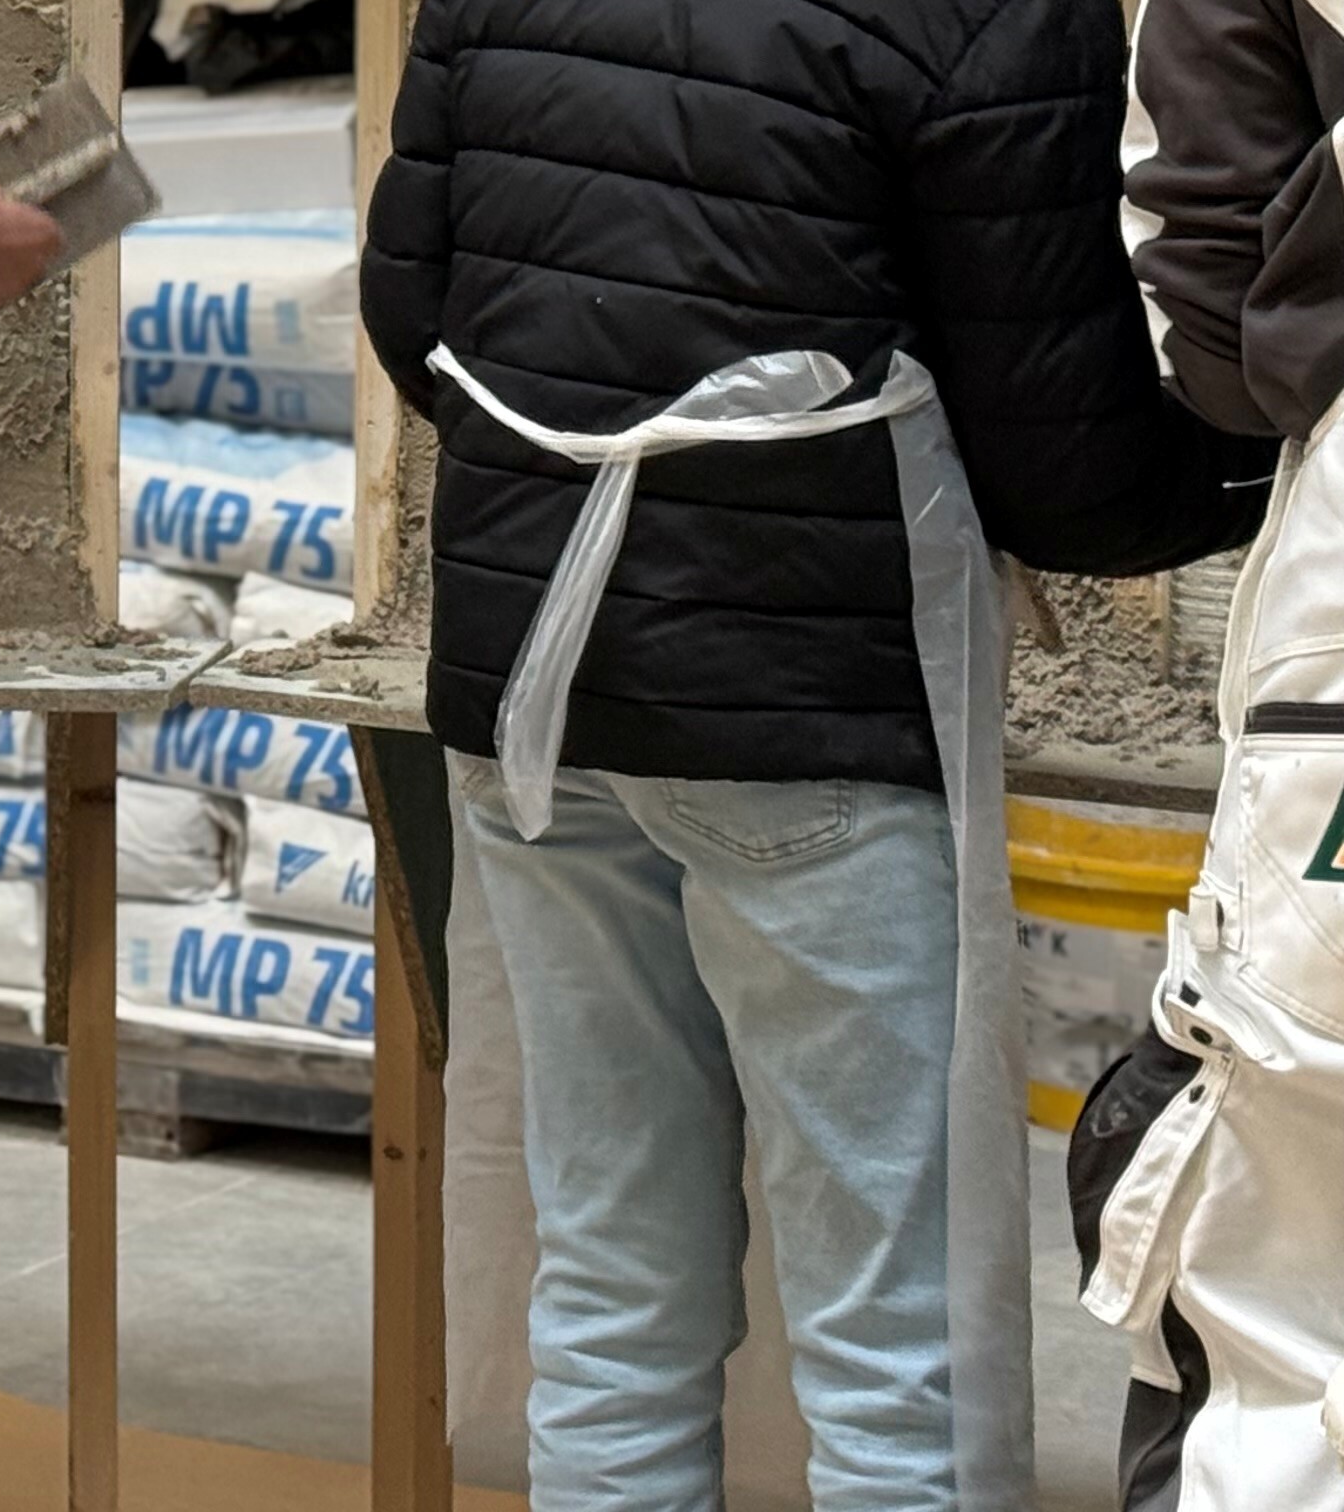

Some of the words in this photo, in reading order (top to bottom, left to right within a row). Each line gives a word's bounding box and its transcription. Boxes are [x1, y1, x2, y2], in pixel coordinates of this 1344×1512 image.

[126, 281, 249, 357] MP
[134, 477, 251, 563] MP
[267, 499, 343, 580] 75
[154, 702, 274, 789] MP
[285, 723, 353, 810] 75
[169, 927, 291, 1018] MP
[306, 947, 374, 1035] 75
